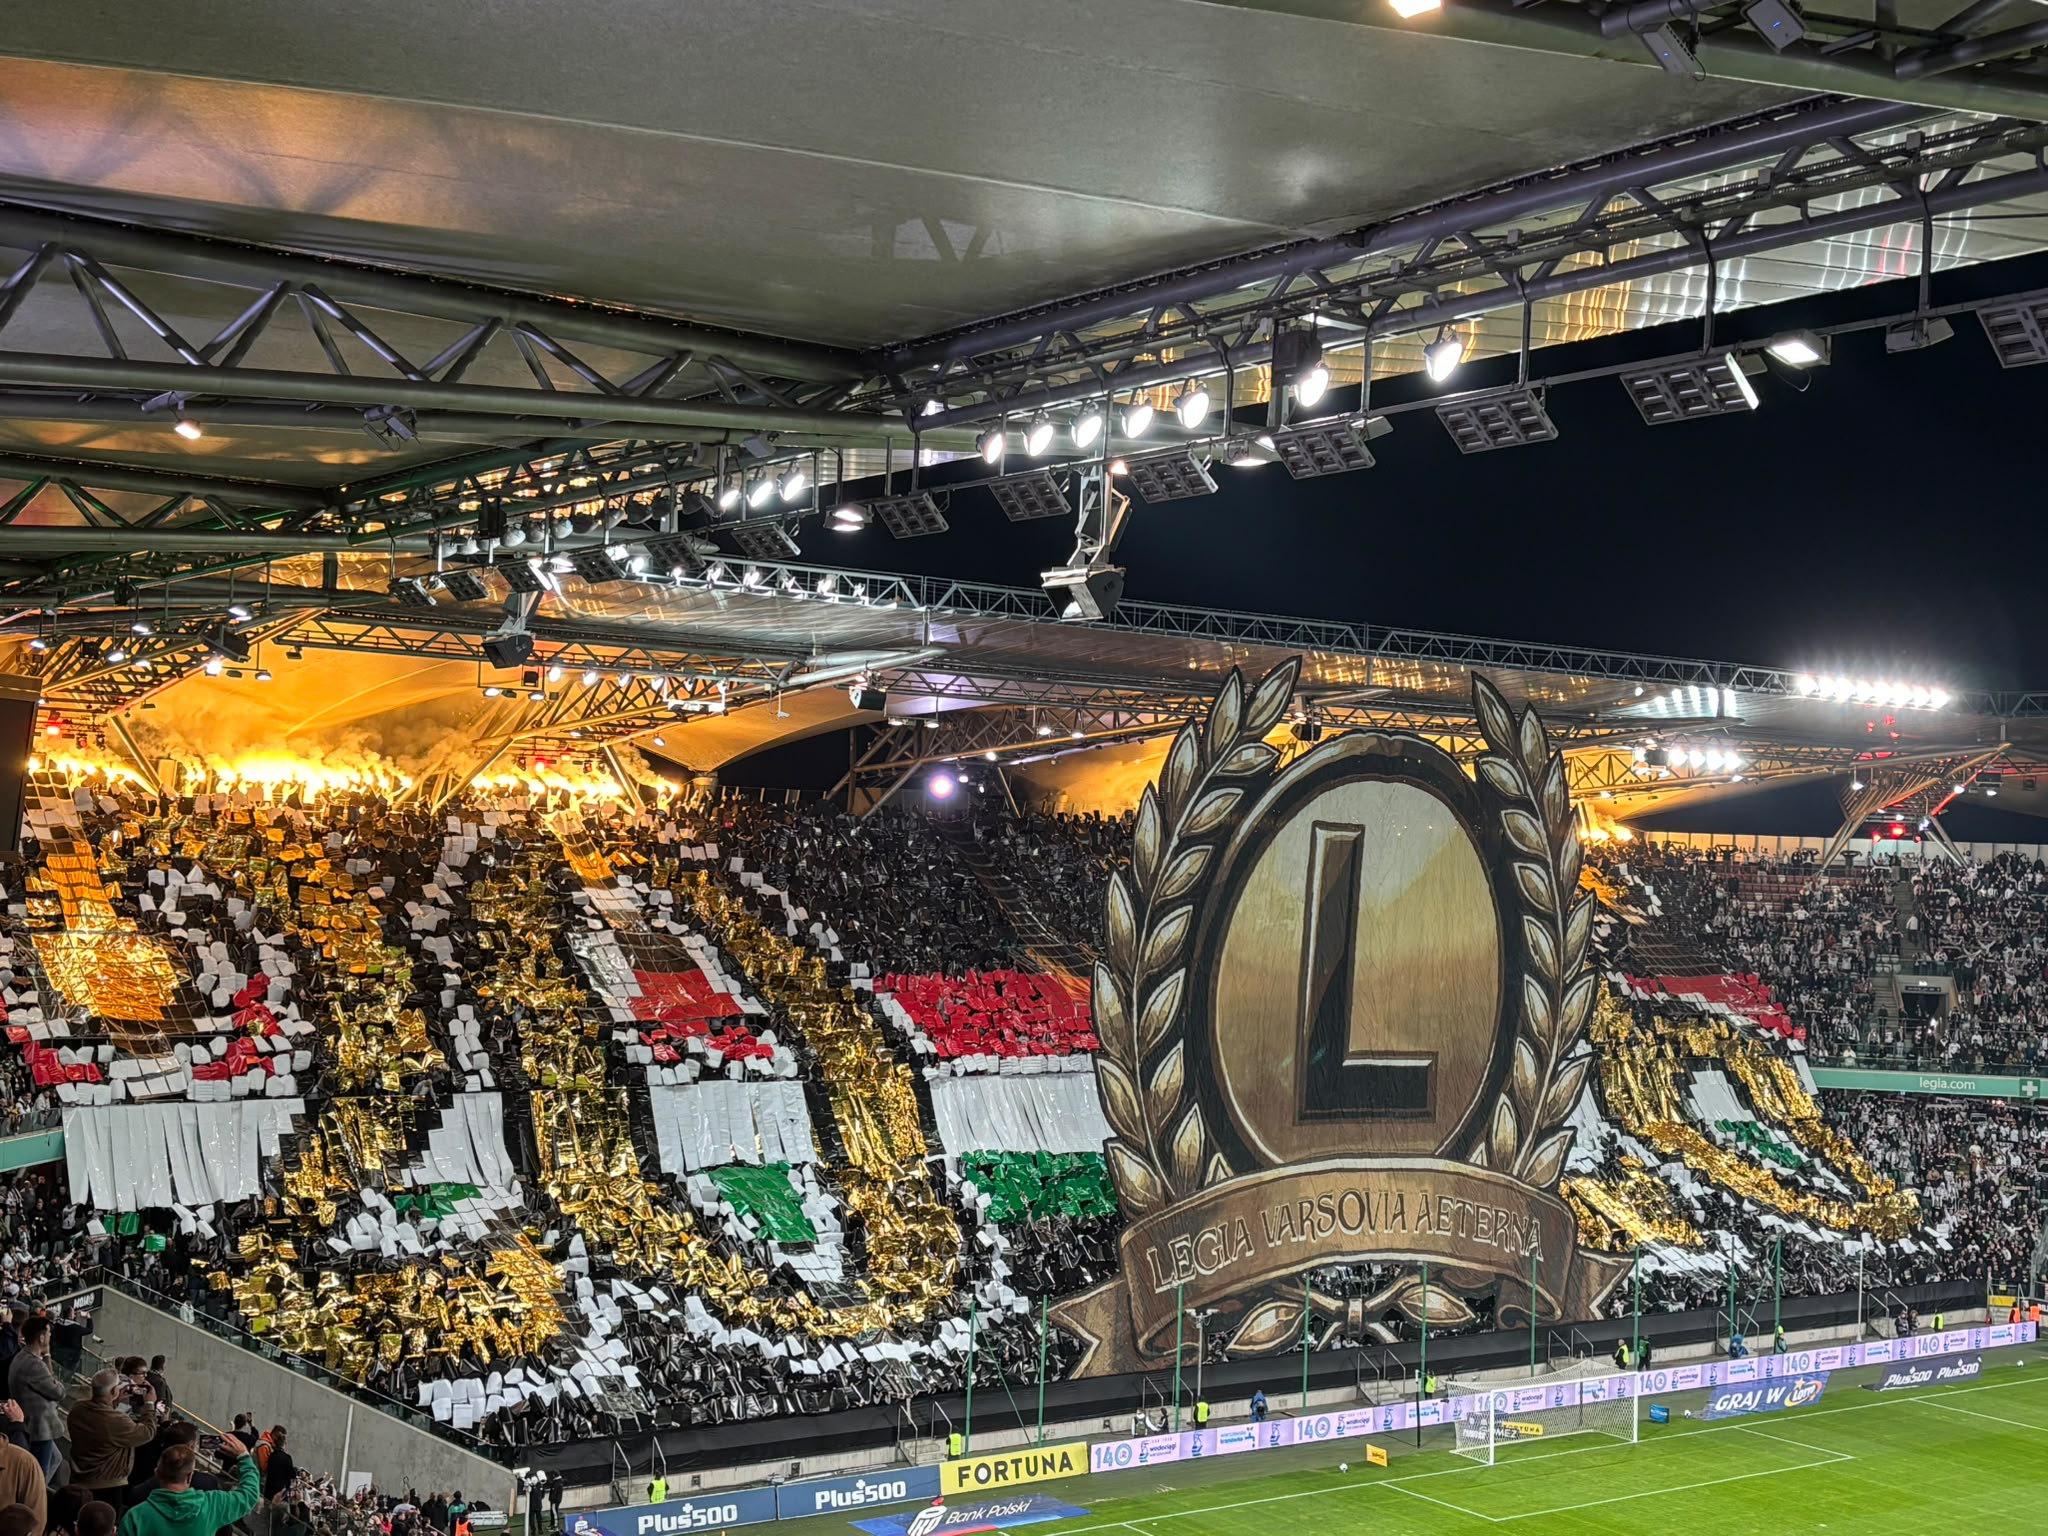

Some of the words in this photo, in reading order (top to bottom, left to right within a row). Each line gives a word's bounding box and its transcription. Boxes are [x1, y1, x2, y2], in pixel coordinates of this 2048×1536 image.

[1294, 820, 1439, 1126] L
[1919, 1076, 1976, 1090] legia.com
[1146, 1216, 1255, 1294] LEGIA
[1260, 1188, 1407, 1249] VARSOVIA
[1414, 1191, 1544, 1263] AETERNA
[1715, 1389, 1763, 1412] GRAJ
[1766, 1386, 1786, 1404] W
[1297, 1416, 1331, 1441] 140
[957, 1451, 1074, 1488] FORTUNA
[1095, 1442, 1133, 1469] 140
[815, 1480, 906, 1510] Plus500
[638, 1503, 738, 1535] Plus500
[945, 1506, 987, 1525] Bank
[987, 1499, 1033, 1519] Polski
